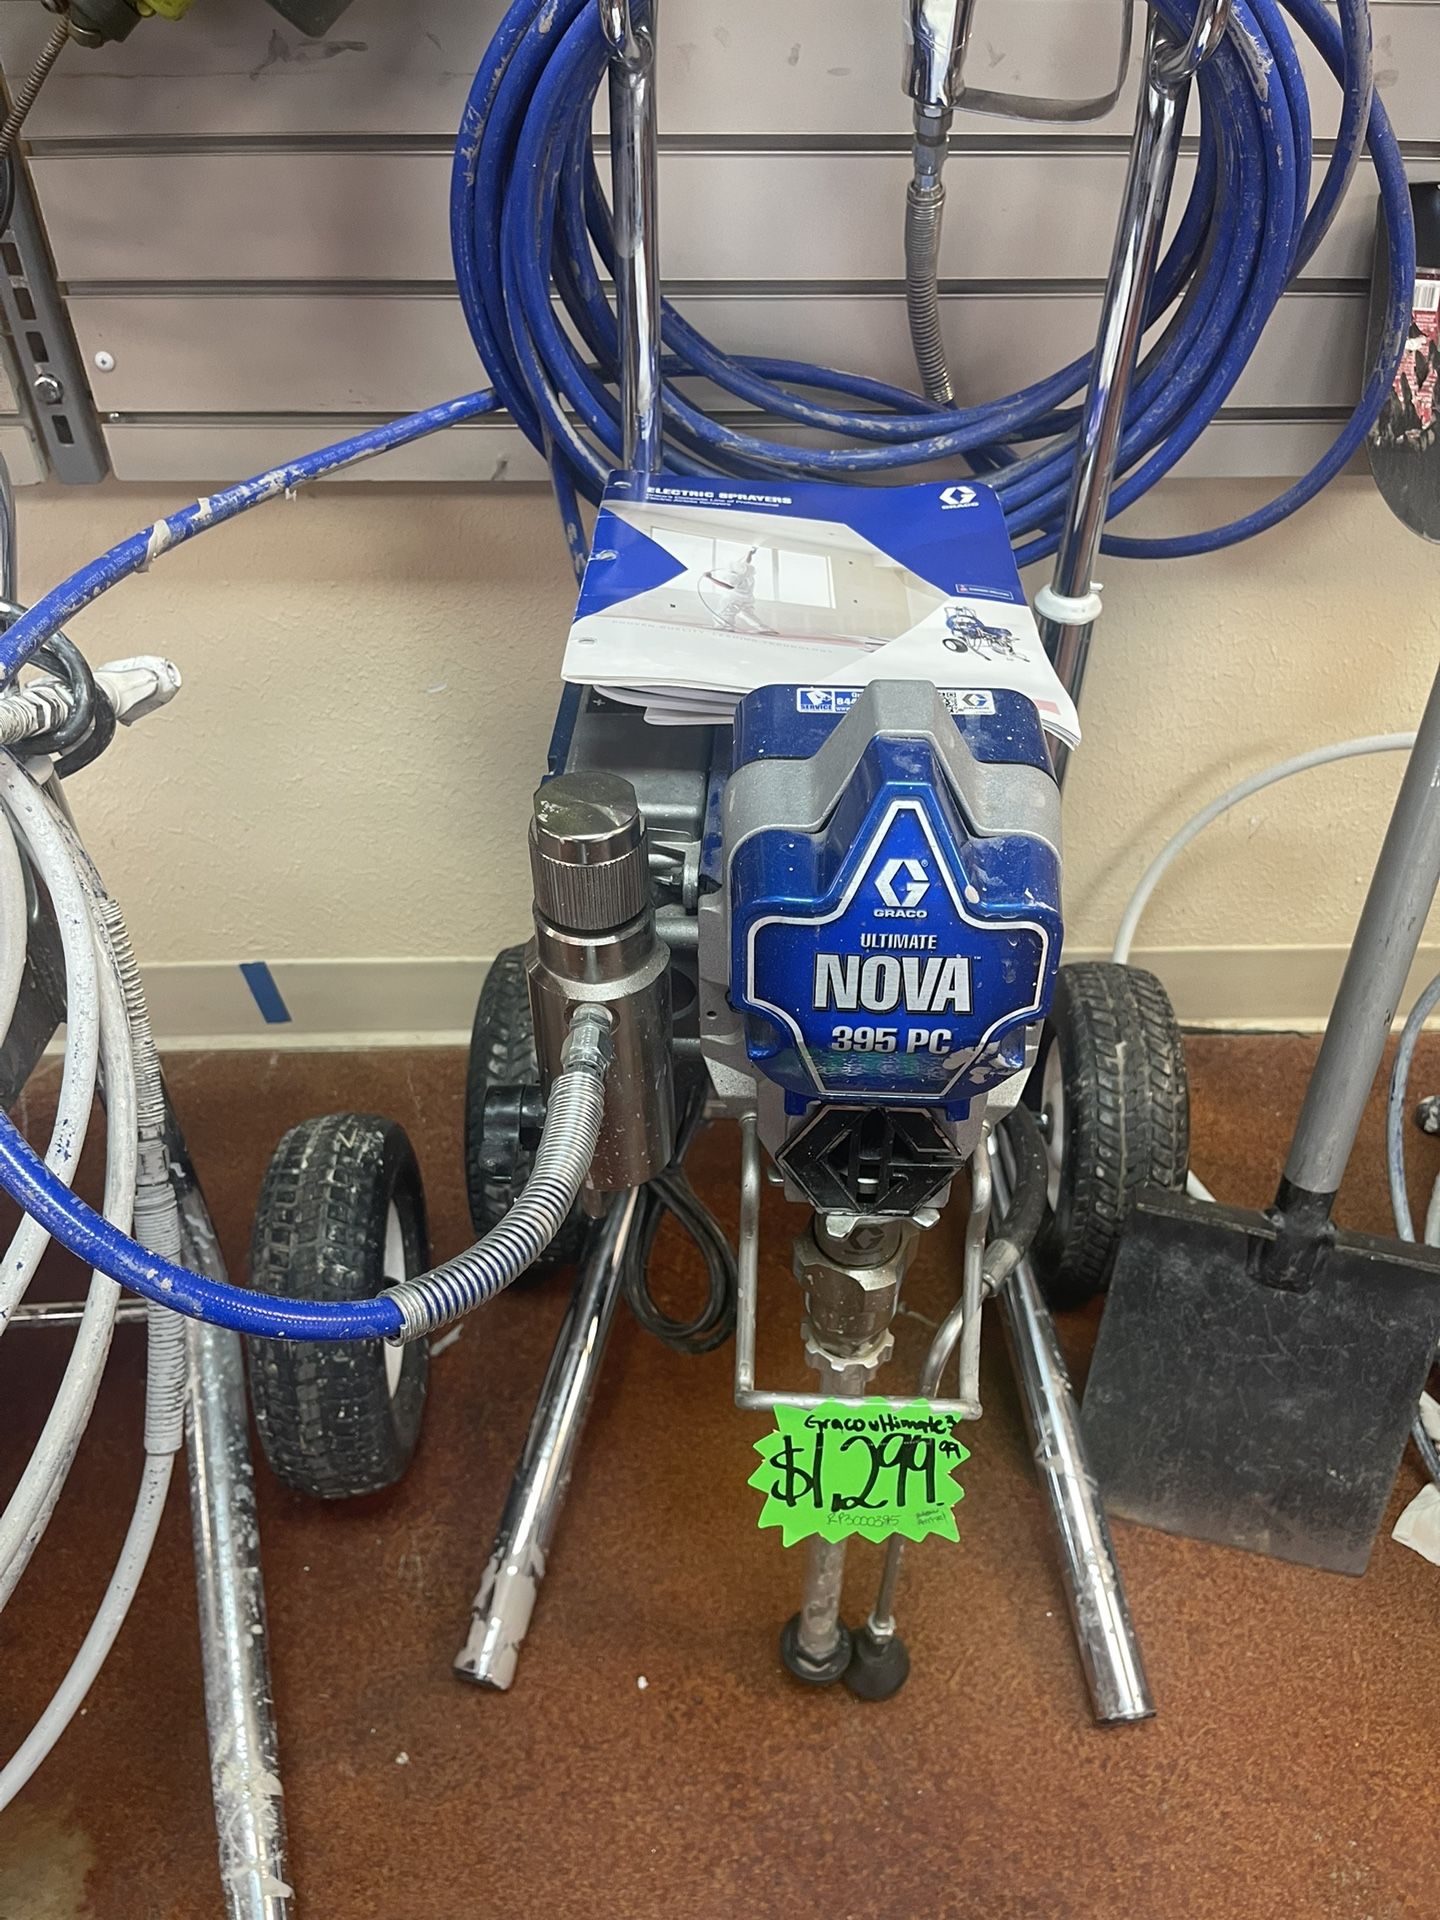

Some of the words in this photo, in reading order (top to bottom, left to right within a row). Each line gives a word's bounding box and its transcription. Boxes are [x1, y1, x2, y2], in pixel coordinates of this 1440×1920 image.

[646, 487, 714, 498] ELECTRIC
[718, 492, 793, 504] SPRAYERS
[873, 908, 928, 918] GRACO
[860, 932, 937, 950] ULTIMATE
[813, 953, 973, 1013] NOVA
[831, 1025, 898, 1054] 395
[906, 1028, 953, 1055] PC
